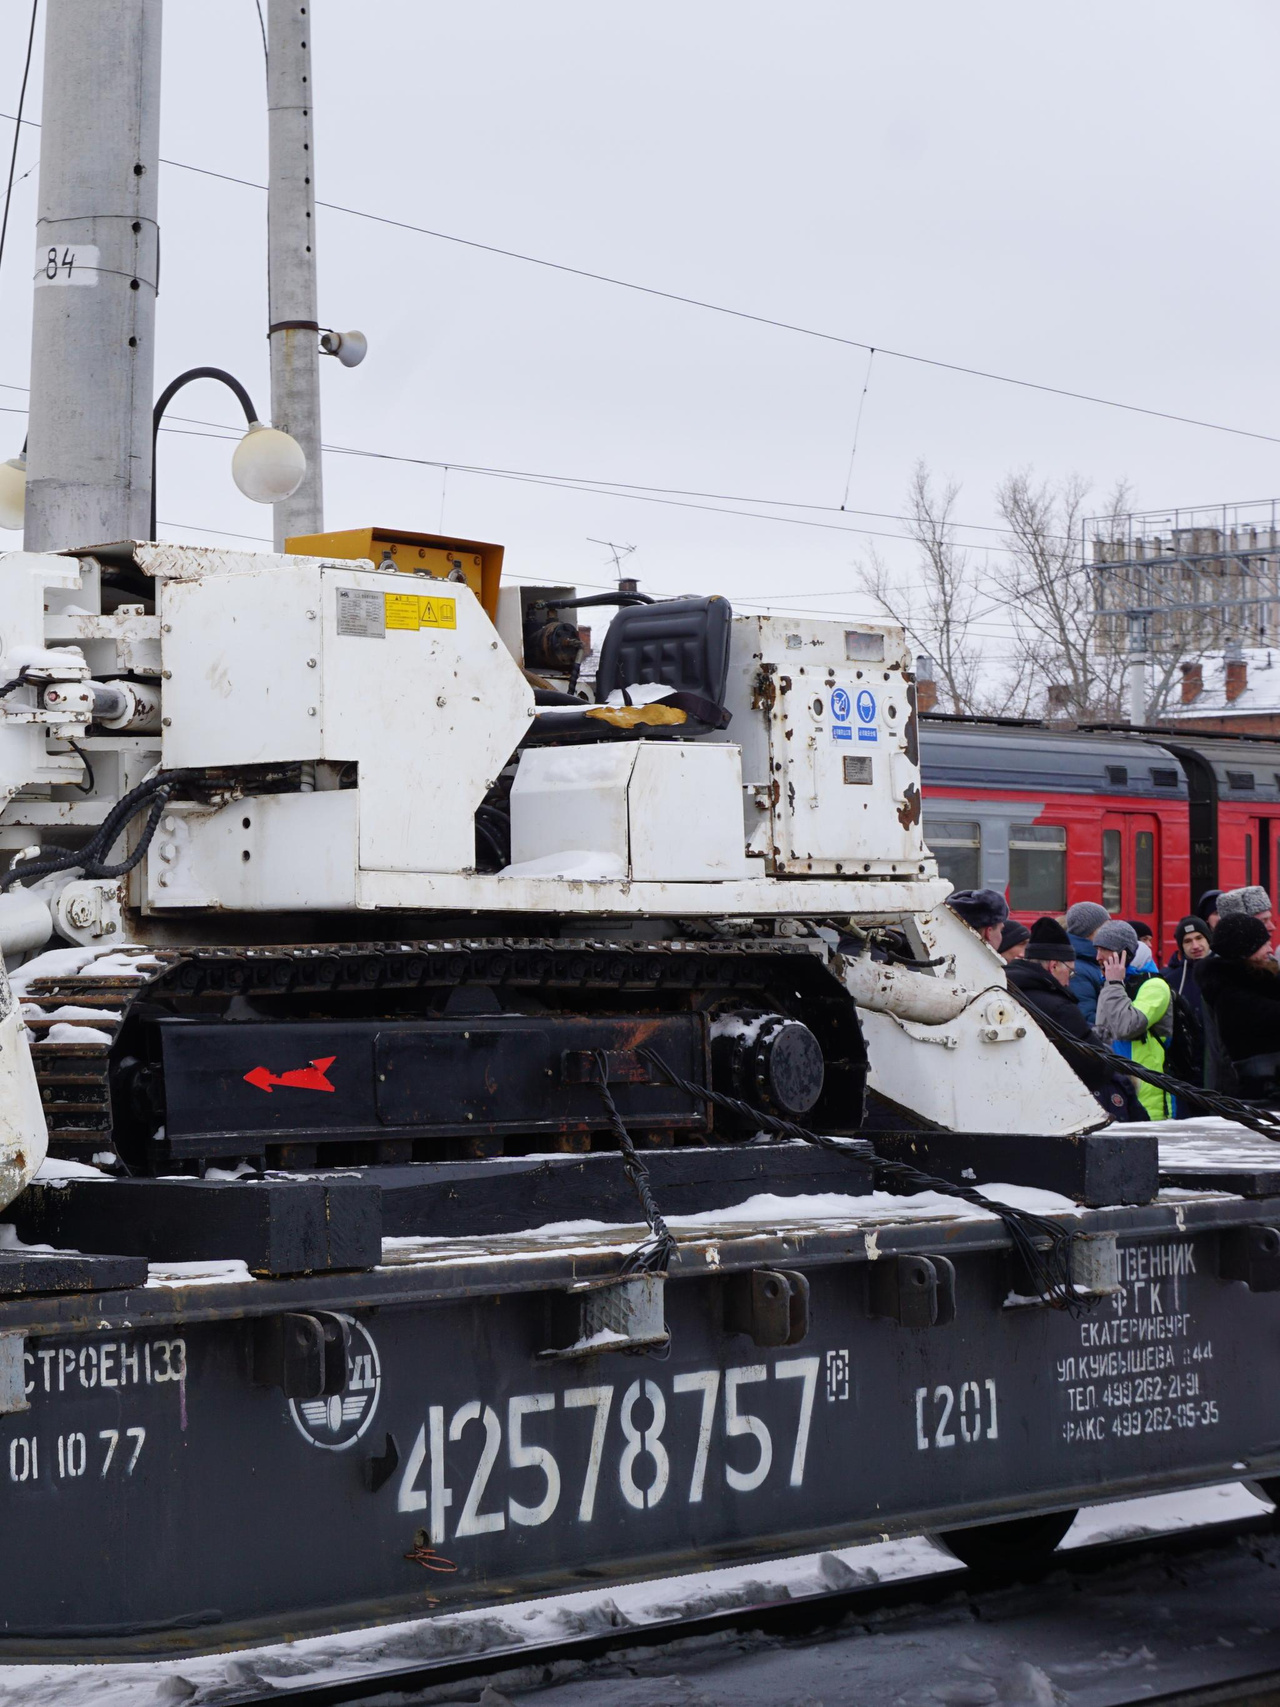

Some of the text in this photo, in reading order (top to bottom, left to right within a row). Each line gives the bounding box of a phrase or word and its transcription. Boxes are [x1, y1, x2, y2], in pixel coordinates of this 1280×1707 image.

[46, 247, 75, 280] 84
[1081, 1313, 1191, 1347] ЕКАТЕРИНБУРГ
[1062, 1416, 1105, 1443] ФАКС
[9, 1427, 147, 1482] 01 10 77
[398, 1356, 820, 1543] 42578757
